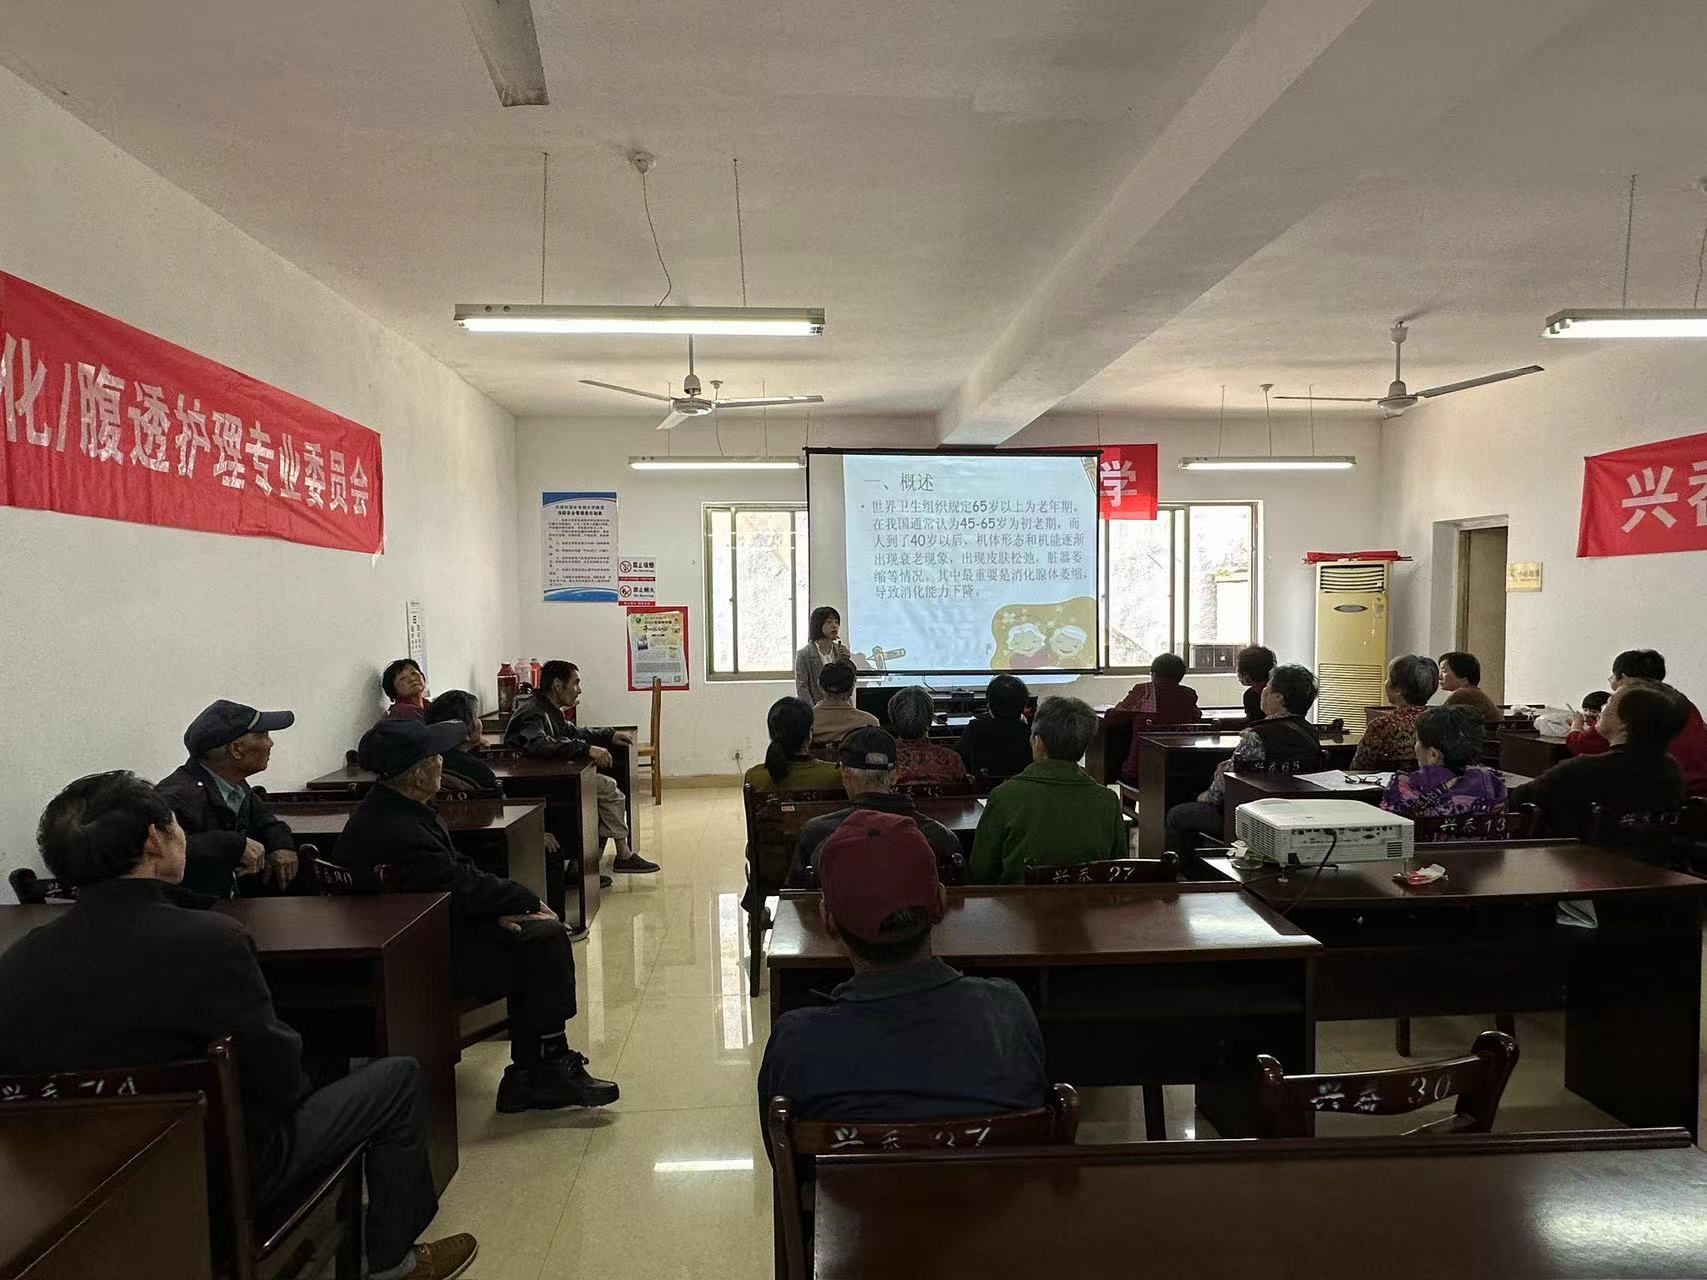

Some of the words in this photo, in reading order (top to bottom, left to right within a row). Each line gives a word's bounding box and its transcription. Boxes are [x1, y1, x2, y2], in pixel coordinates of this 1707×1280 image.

[863, 472, 934, 492] 一、概述
[1109, 866, 1134, 882] 27
[1408, 1077, 1450, 1104] 30
